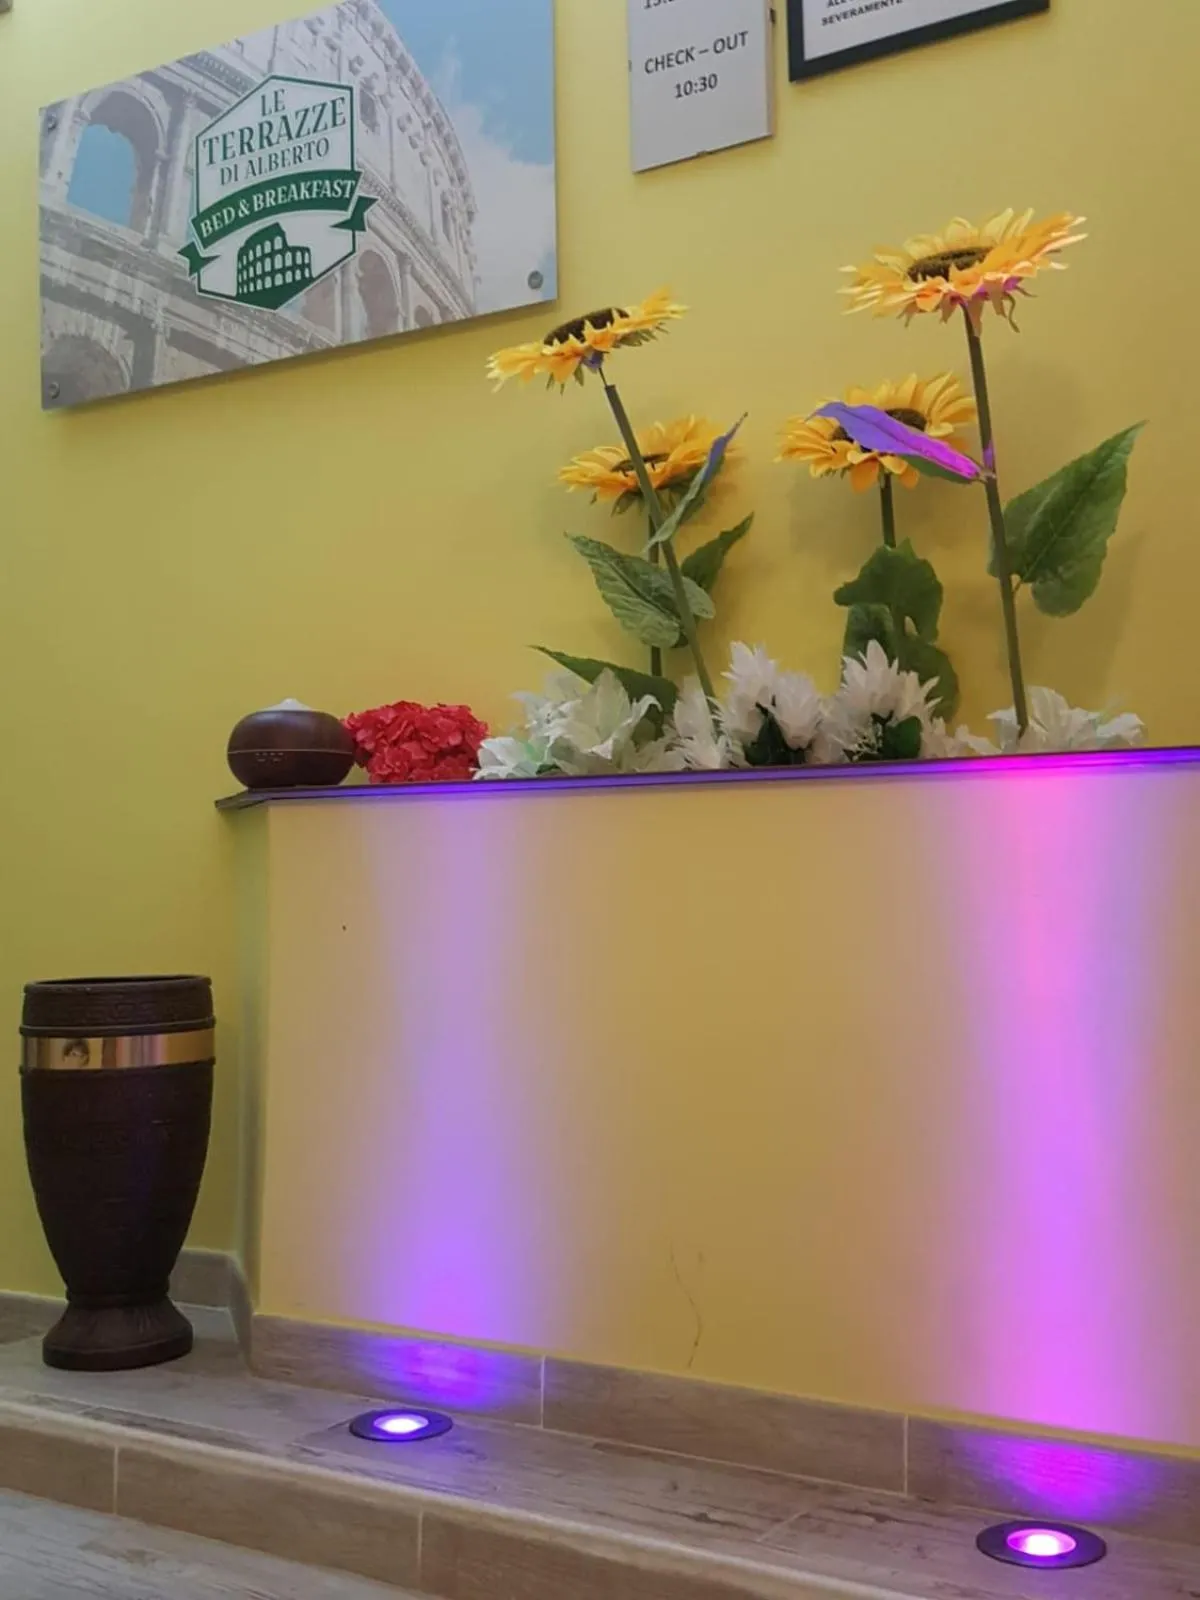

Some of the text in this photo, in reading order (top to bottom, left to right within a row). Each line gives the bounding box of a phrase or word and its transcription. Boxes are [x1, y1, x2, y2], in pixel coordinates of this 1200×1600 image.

[644, 46, 696, 74] CHECK
[712, 30, 749, 54] OUT
[261, 88, 286, 117] LE
[674, 73, 719, 99] 10:30
[202, 96, 347, 166] TERRAZZE
[220, 137, 330, 186] DI ALBERTO
[200, 179, 357, 239] BED & BREAKFAST
